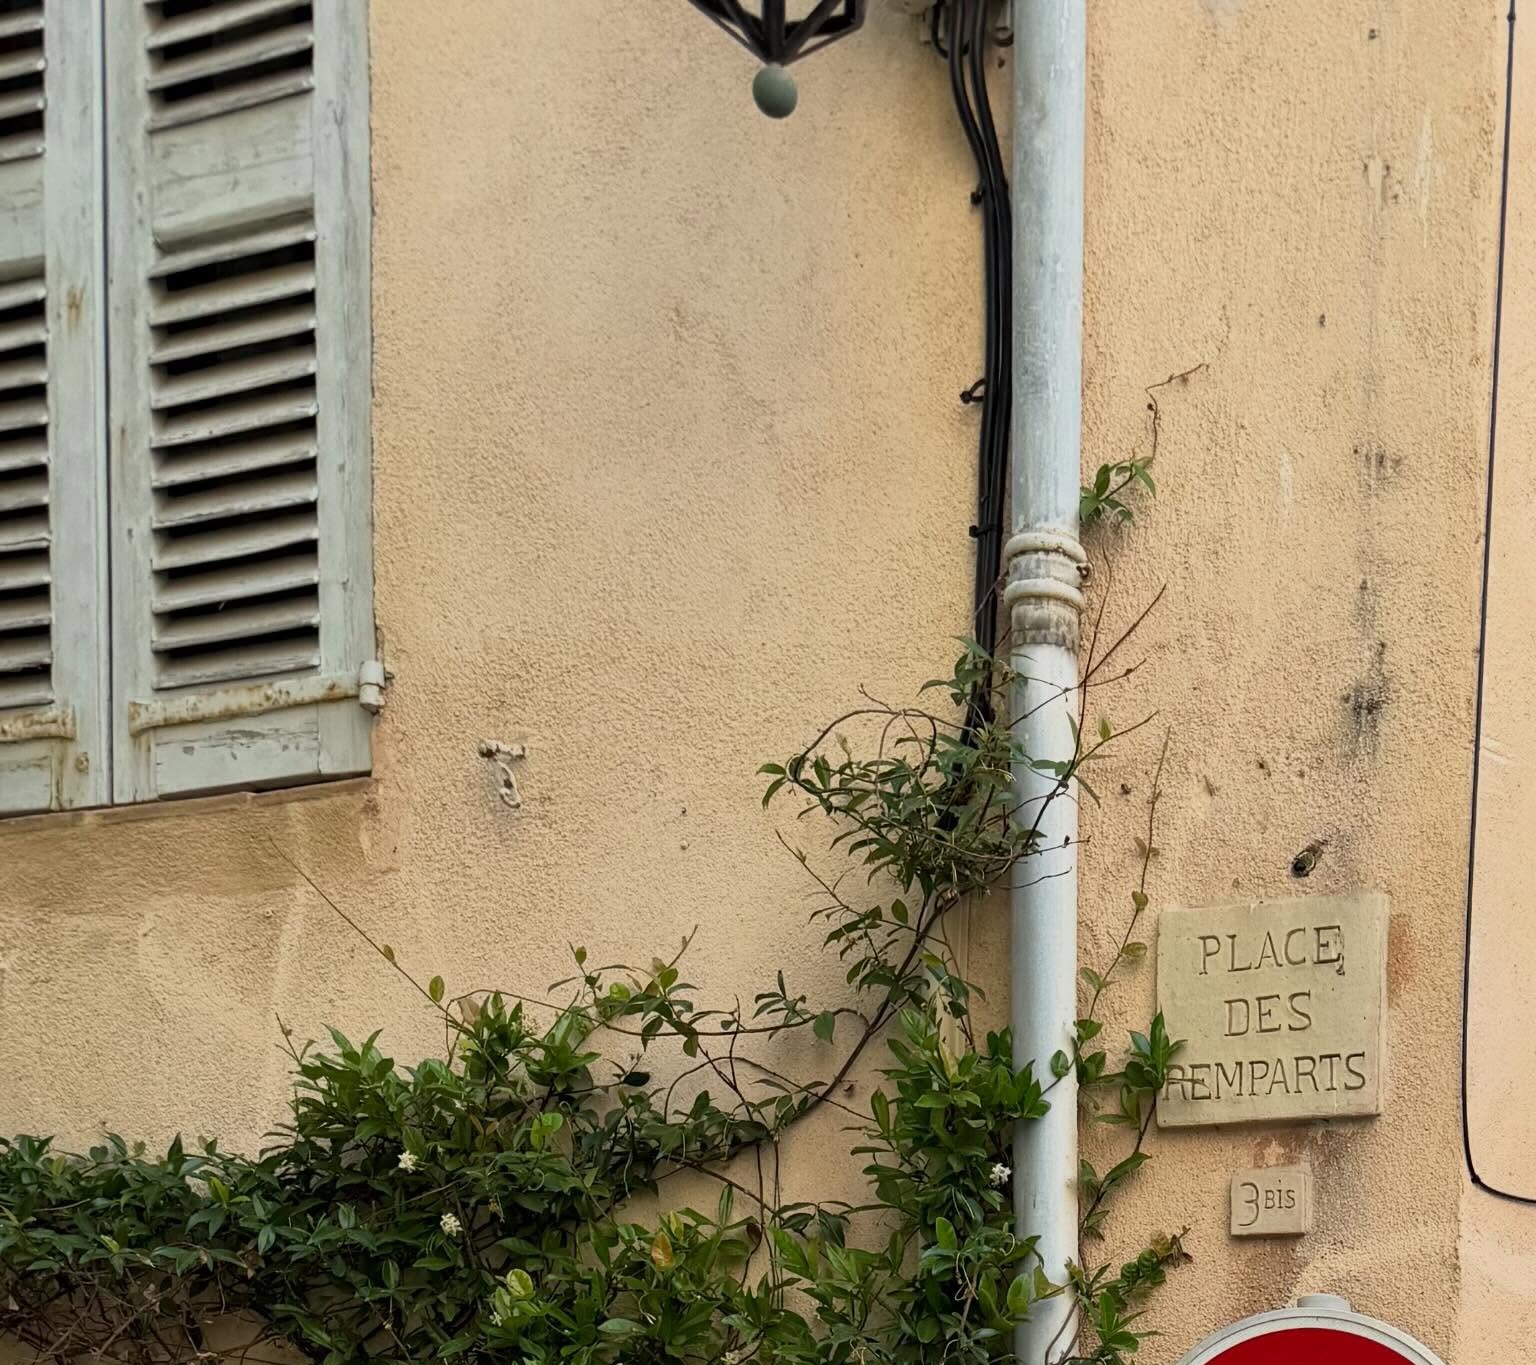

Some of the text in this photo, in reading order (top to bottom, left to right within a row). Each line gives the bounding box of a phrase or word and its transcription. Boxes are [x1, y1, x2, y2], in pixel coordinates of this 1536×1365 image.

[1198, 925, 1343, 976] PLACE
[1224, 990, 1312, 1037] DES
[1162, 1052, 1366, 1101] REMPARTS
